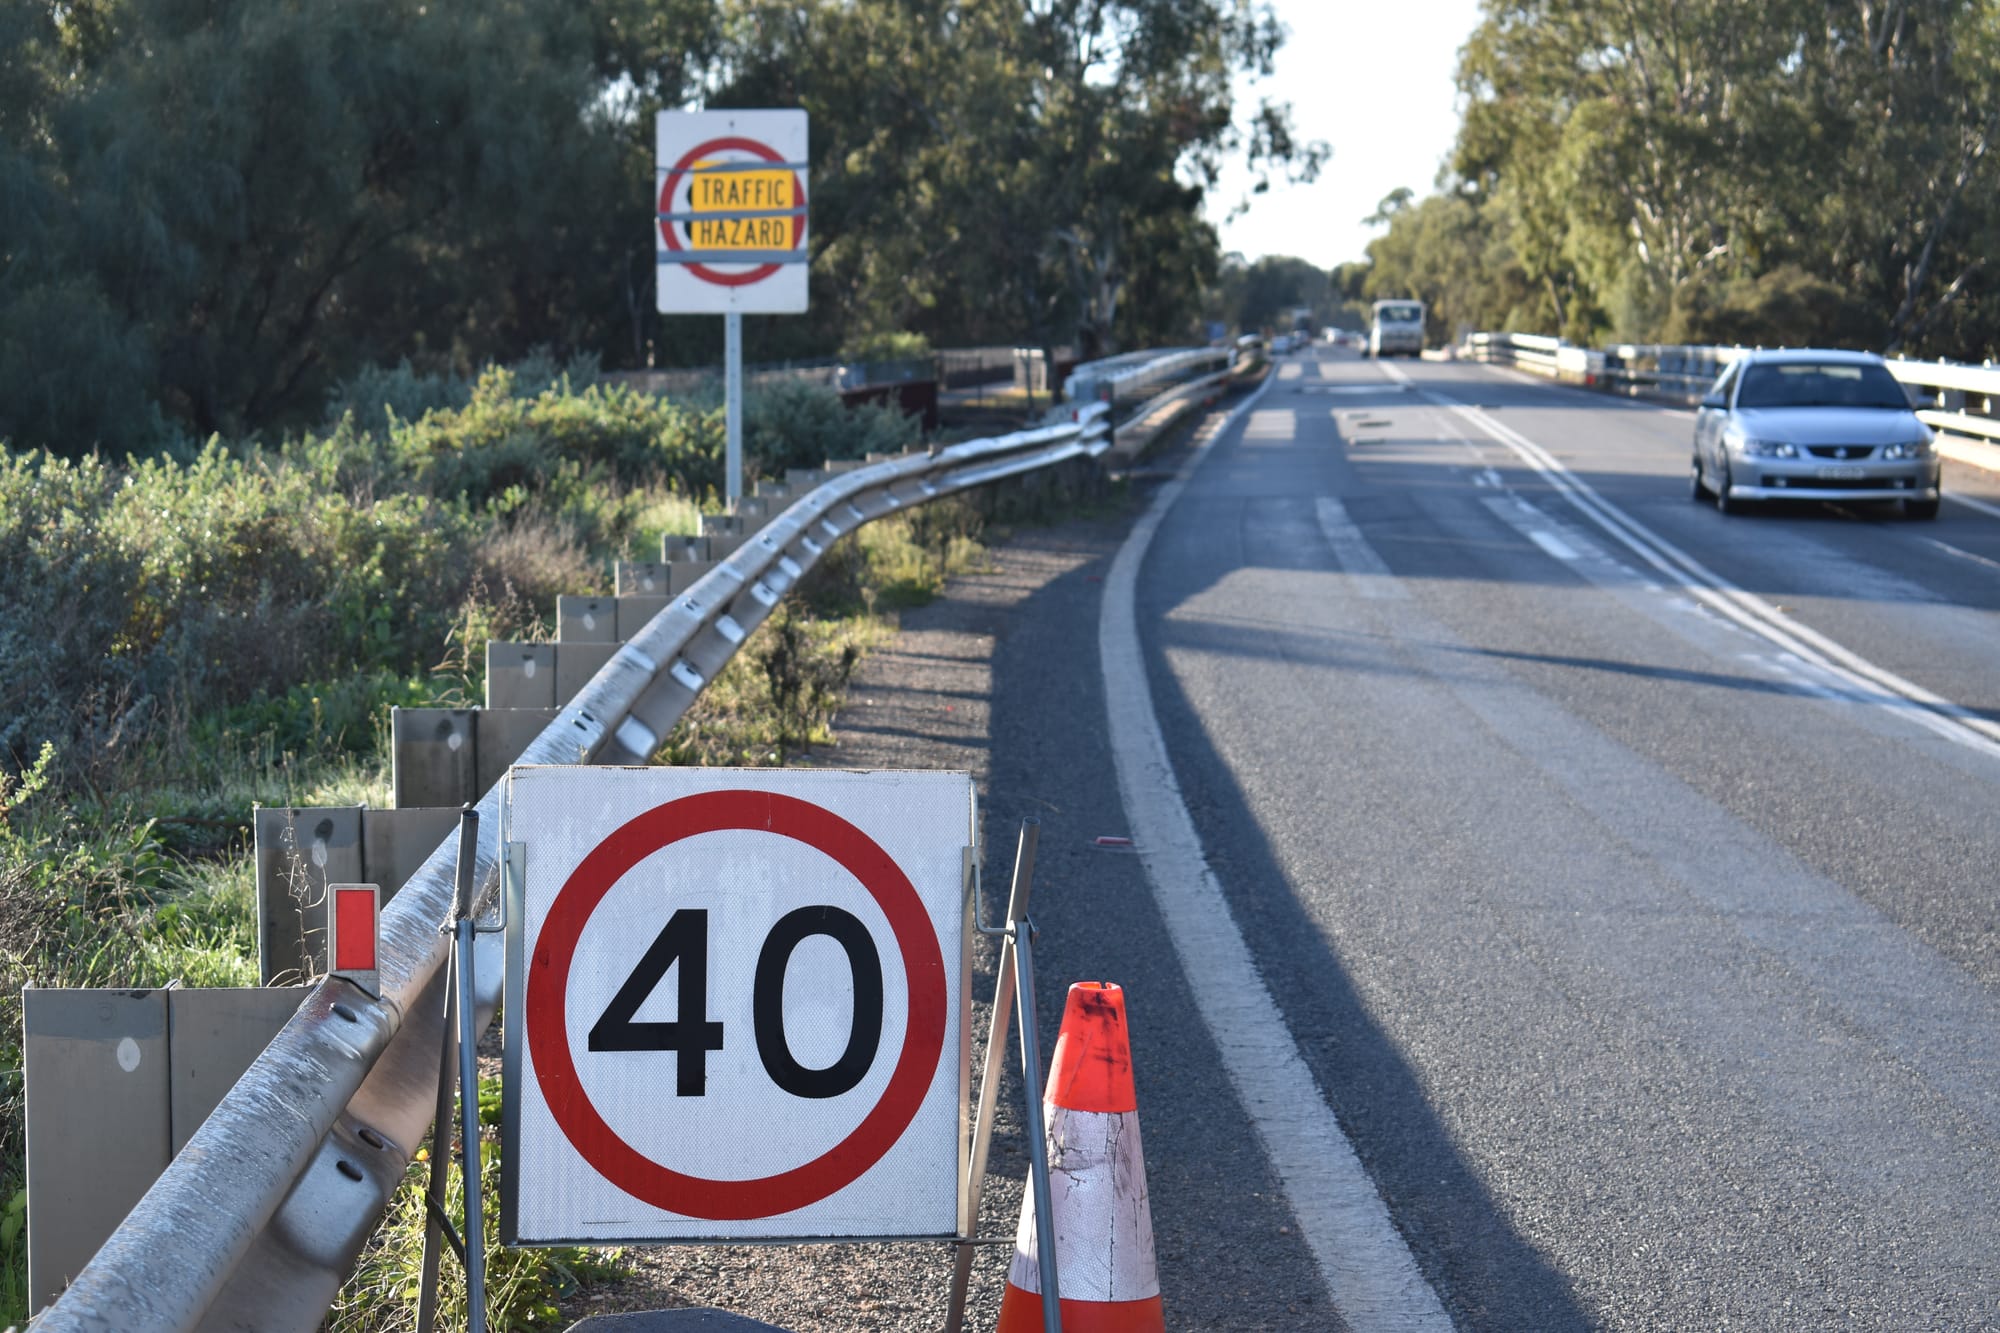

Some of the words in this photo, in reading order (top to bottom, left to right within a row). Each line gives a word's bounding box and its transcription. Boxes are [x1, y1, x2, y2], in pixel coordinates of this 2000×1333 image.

[702, 179, 785, 205] TRAFFIC
[700, 219, 785, 246] HAZARD
[588, 905, 883, 1099] 40
